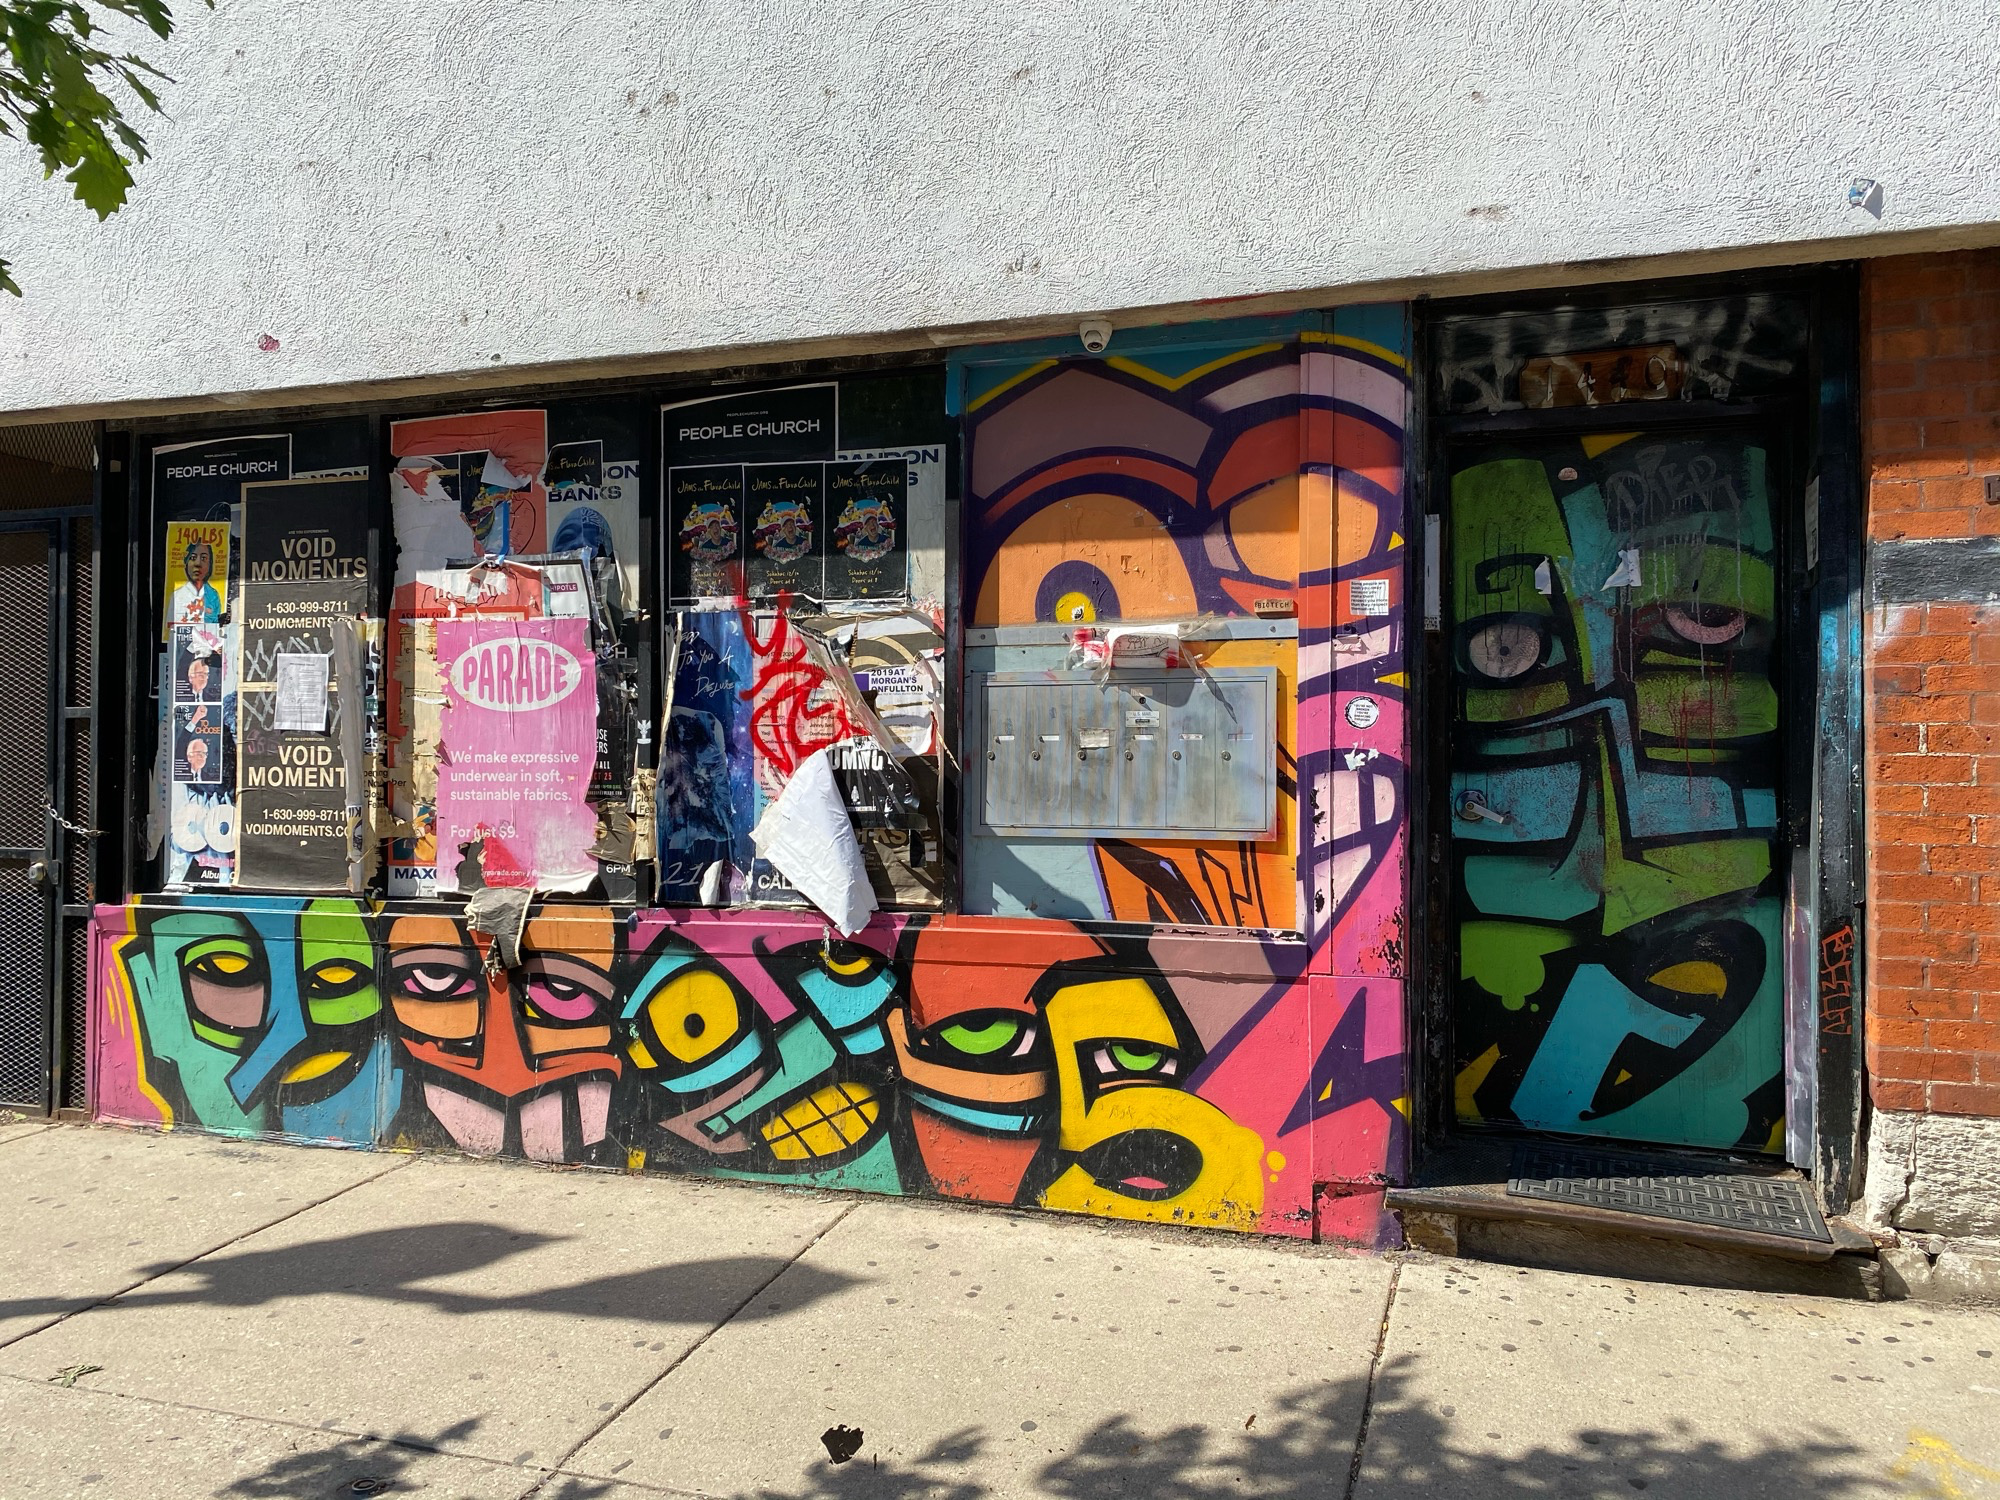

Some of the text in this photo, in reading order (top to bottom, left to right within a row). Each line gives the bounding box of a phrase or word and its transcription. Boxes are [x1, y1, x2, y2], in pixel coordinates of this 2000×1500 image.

[679, 419, 820, 441] PEOPLE CHURCH
[167, 460, 278, 479] PEOPLE CHURCH
[175, 527, 225, 548] 140 LBS
[281, 537, 336, 559] VOID
[251, 557, 367, 582] MOMENTS
[550, 583, 577, 591] HIPOTLE
[266, 601, 348, 614] 1-630-999-8711
[249, 616, 354, 630] VOIDMOMENTS.
[681, 631, 700, 645] EDD
[718, 645, 734, 672] 4
[462, 644, 569, 704] PARADE
[871, 668, 906, 677] 2019AT
[871, 676, 917, 685] MORGAN'S
[195, 726, 221, 735] CHOOSE
[278, 745, 333, 767] VOID
[450, 750, 579, 768] We make expressive
[248, 765, 346, 788] MOMENT
[450, 768, 564, 784] underwear in soft,
[450, 787, 520, 801] sustainable
[524, 787, 572, 801] fabrics.
[263, 808, 346, 822] 1-630-999-8711
[450, 824, 519, 840] For just $9.
[201, 869, 227, 880] Album
[606, 863, 631, 874] 6PM
